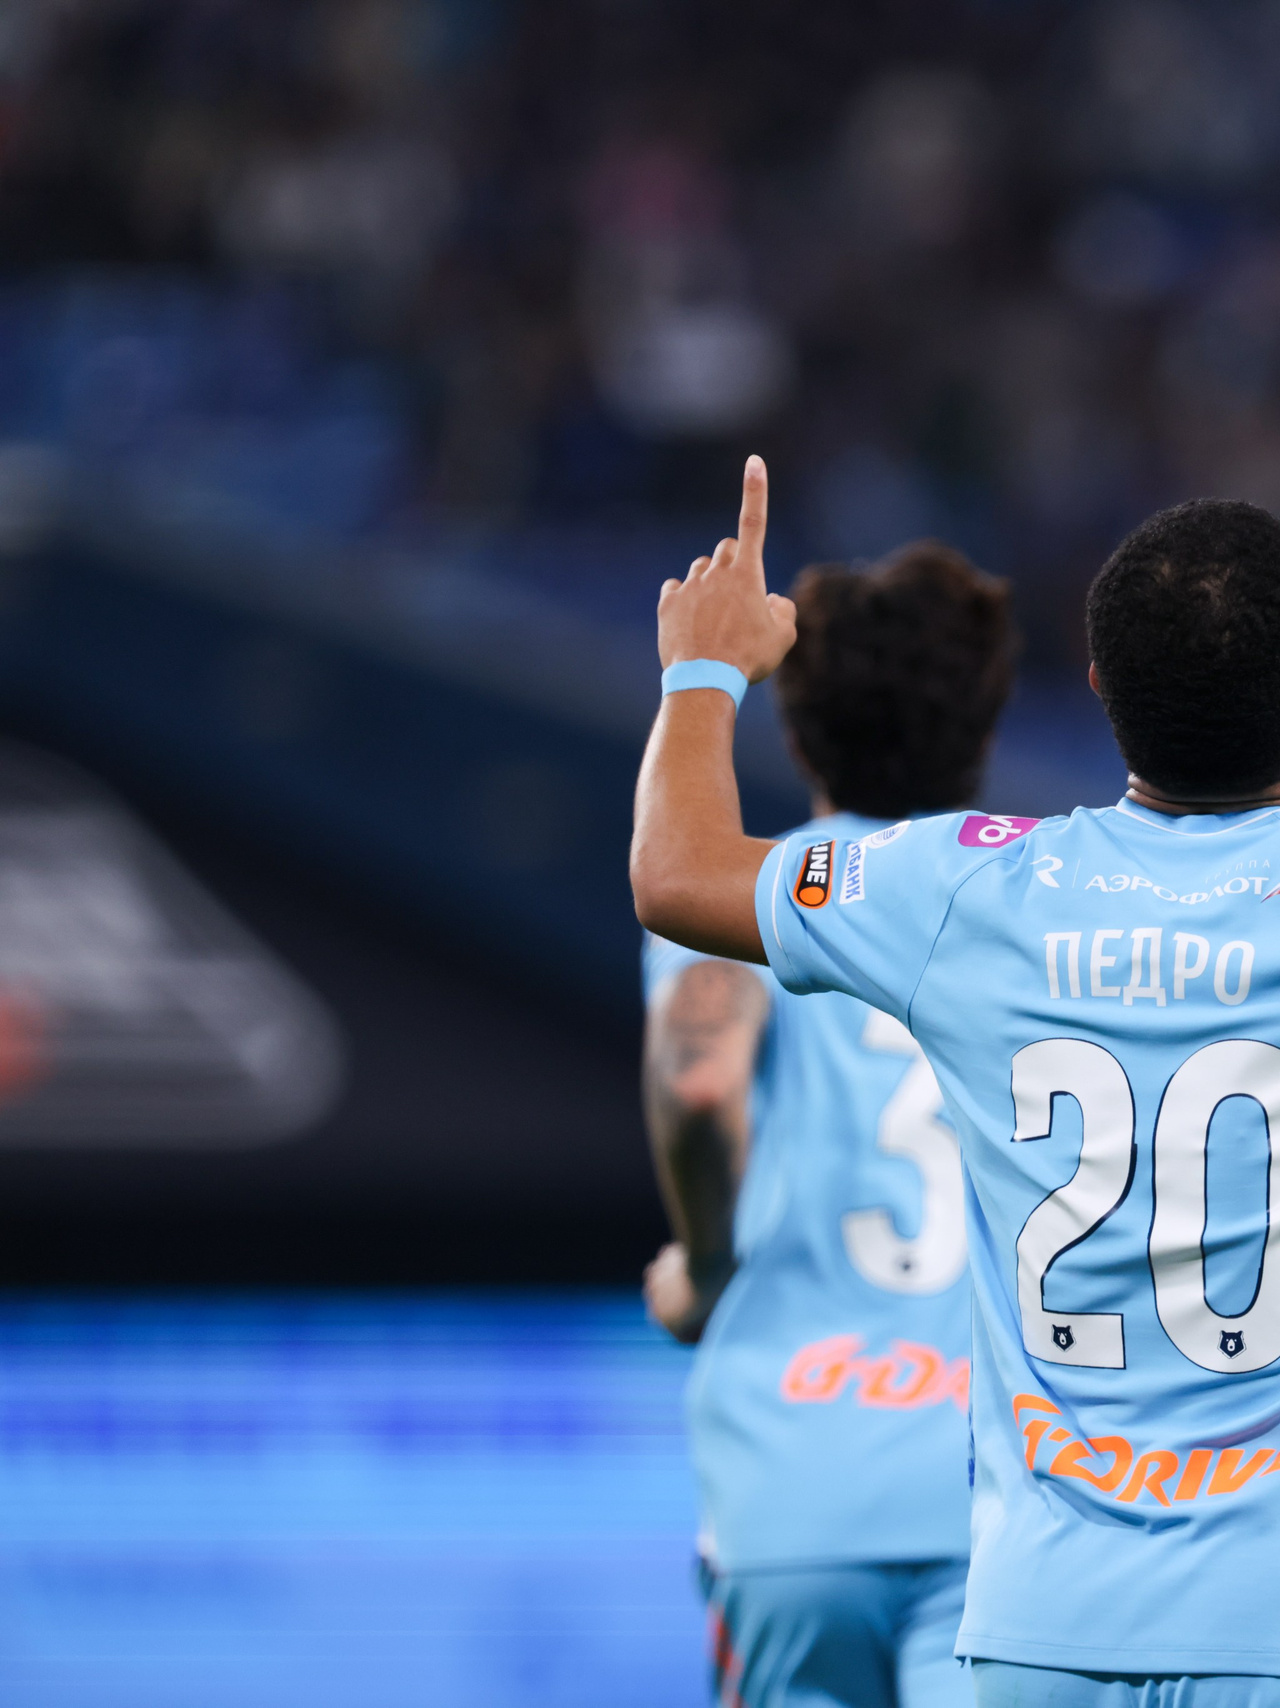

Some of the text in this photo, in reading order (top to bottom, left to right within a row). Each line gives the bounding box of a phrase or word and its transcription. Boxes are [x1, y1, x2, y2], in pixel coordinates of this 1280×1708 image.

[806, 842, 829, 884] INE
[846, 842, 861, 900] МБАНК
[1084, 874, 1270, 905] АЭРОФЛОТ
[1043, 926, 1256, 1008] ПЕДРО
